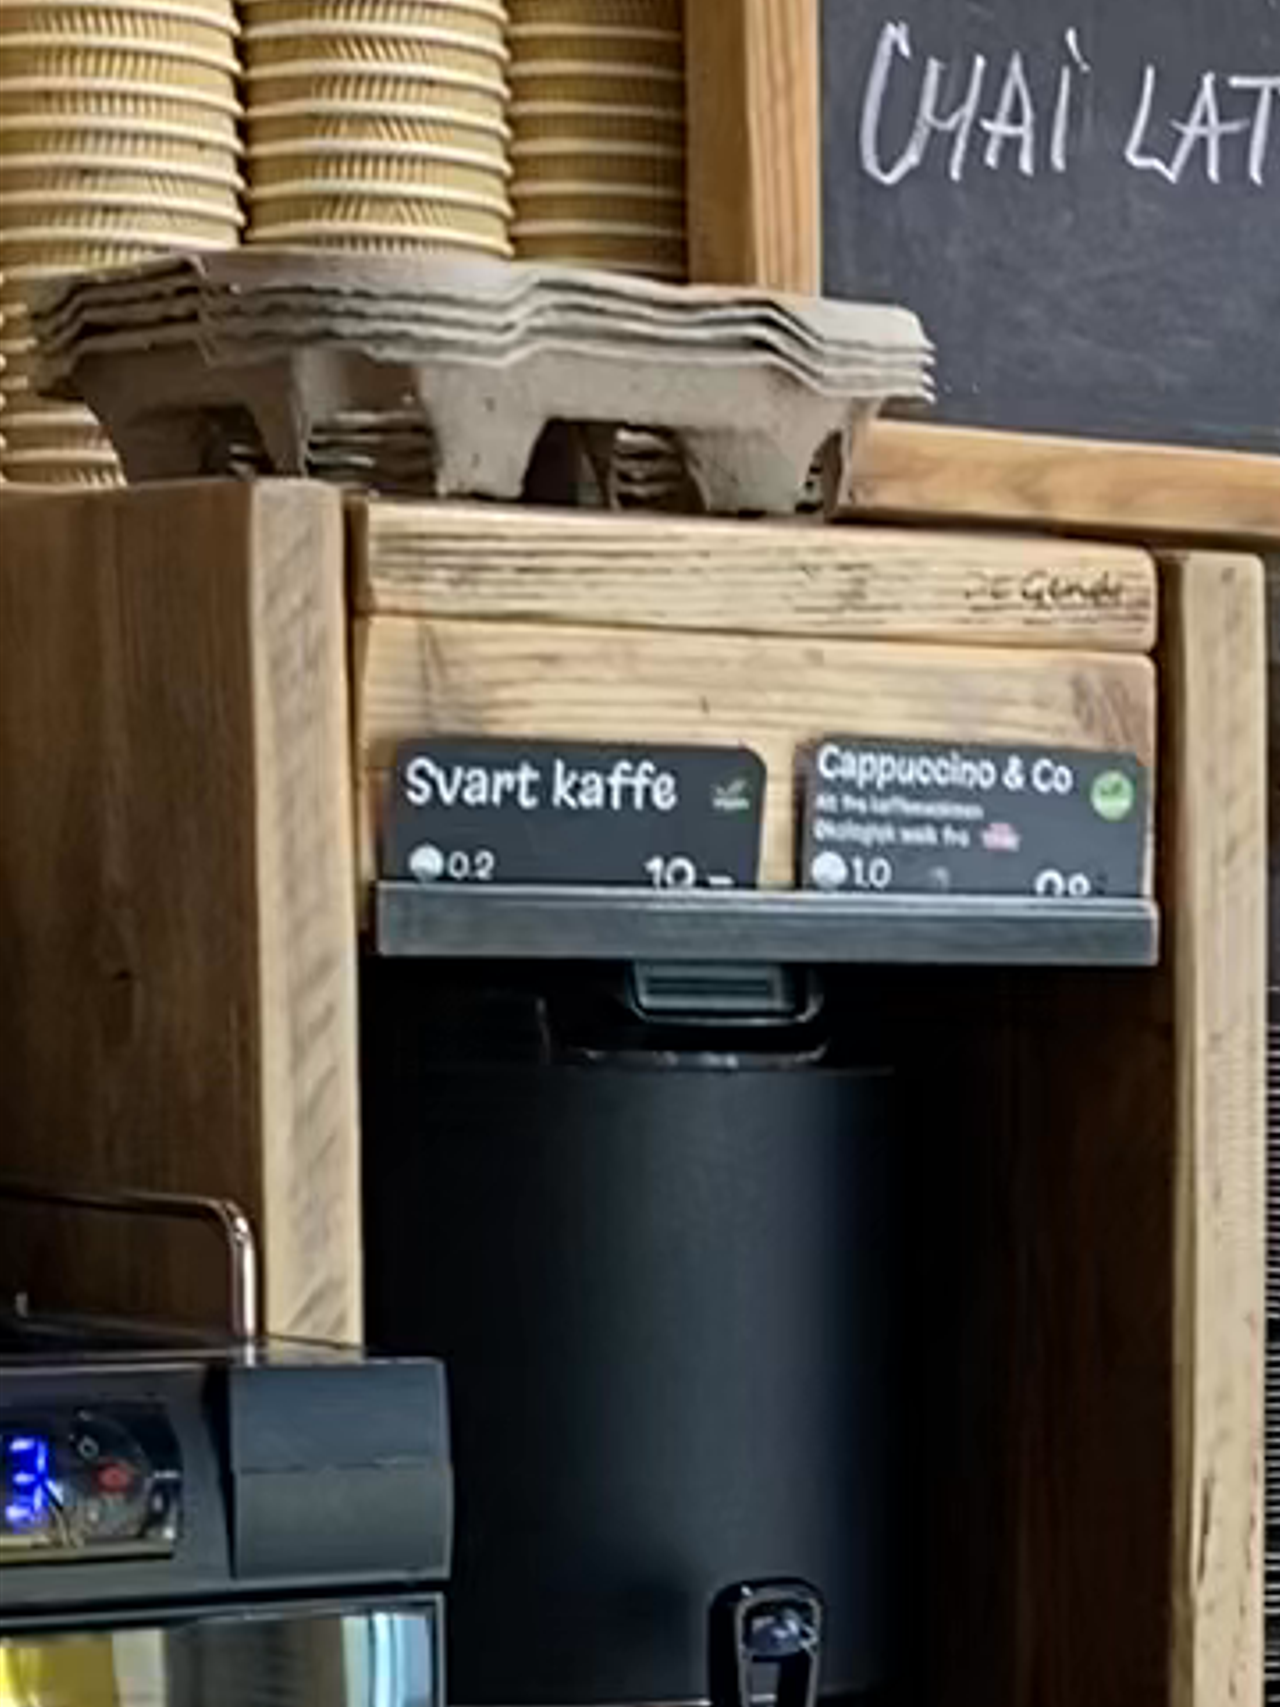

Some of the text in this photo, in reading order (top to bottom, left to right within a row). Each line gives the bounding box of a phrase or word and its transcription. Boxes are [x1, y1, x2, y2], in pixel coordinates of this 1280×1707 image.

[405, 755, 541, 810] Svart
[552, 758, 678, 811] kaffe
[816, 743, 1074, 795] Cappuccino & Co
